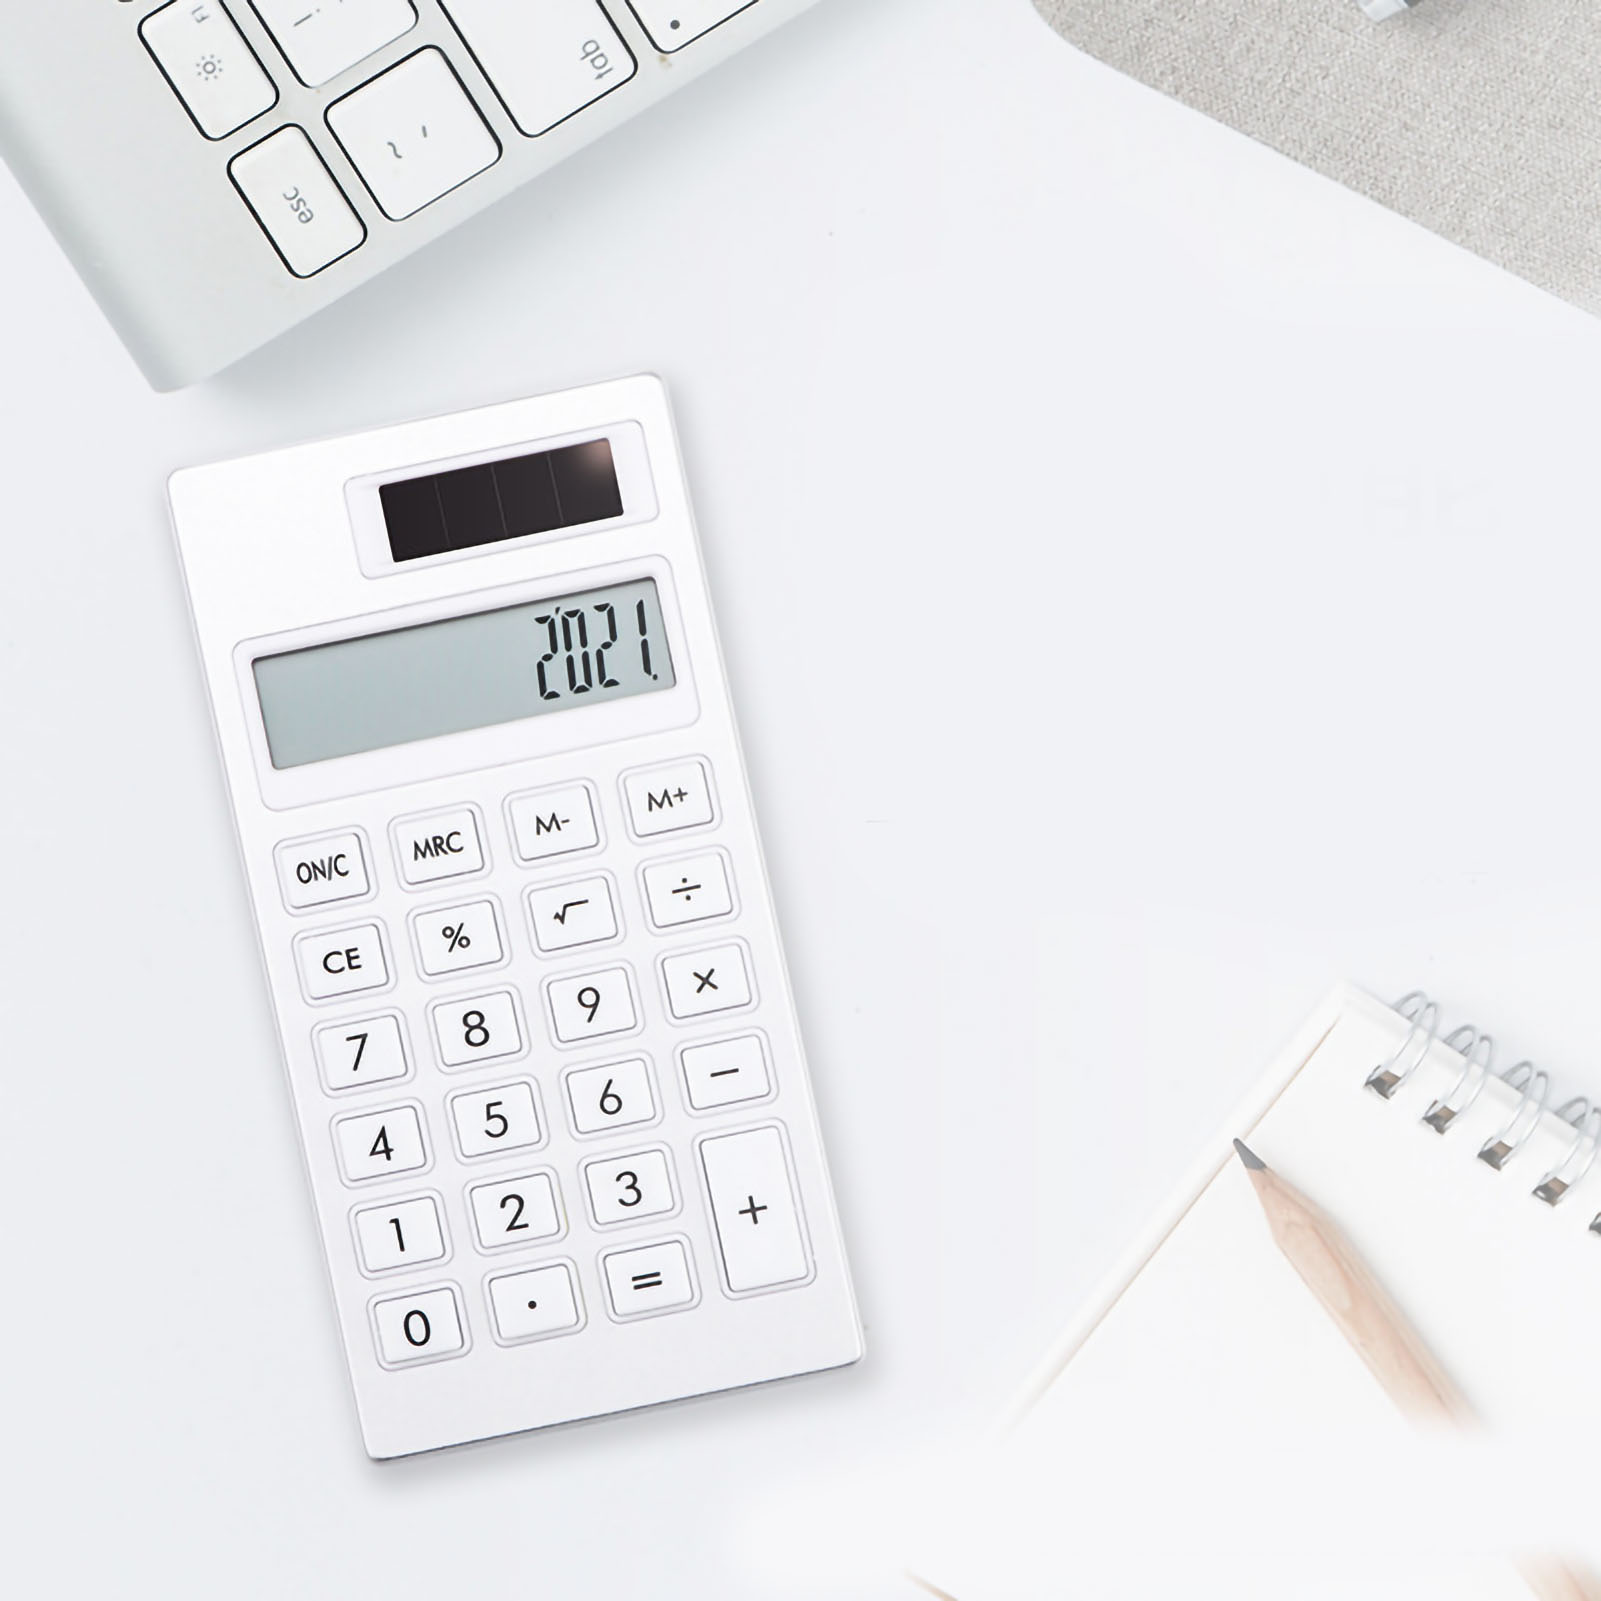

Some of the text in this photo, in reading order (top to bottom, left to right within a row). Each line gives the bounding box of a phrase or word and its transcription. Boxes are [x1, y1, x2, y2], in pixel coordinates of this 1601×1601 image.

[580, 39, 613, 80] tab
[282, 187, 314, 225] esc
[647, 787, 689, 812] M+
[535, 812, 571, 836] M-
[413, 831, 464, 861] MRC
[296, 853, 350, 885] ON/C
[442, 922, 471, 953] %
[322, 947, 363, 974] CE
[577, 987, 601, 1023] 9
[462, 1010, 490, 1048] 8
[345, 1033, 369, 1072] 7
[599, 1079, 623, 1116] 6
[484, 1101, 509, 1138] 5
[369, 1125, 394, 1161] 4
[615, 1171, 642, 1207] 3
[500, 1194, 529, 1232] 2
[389, 1217, 406, 1252] 1
[403, 1309, 431, 1347] 0
